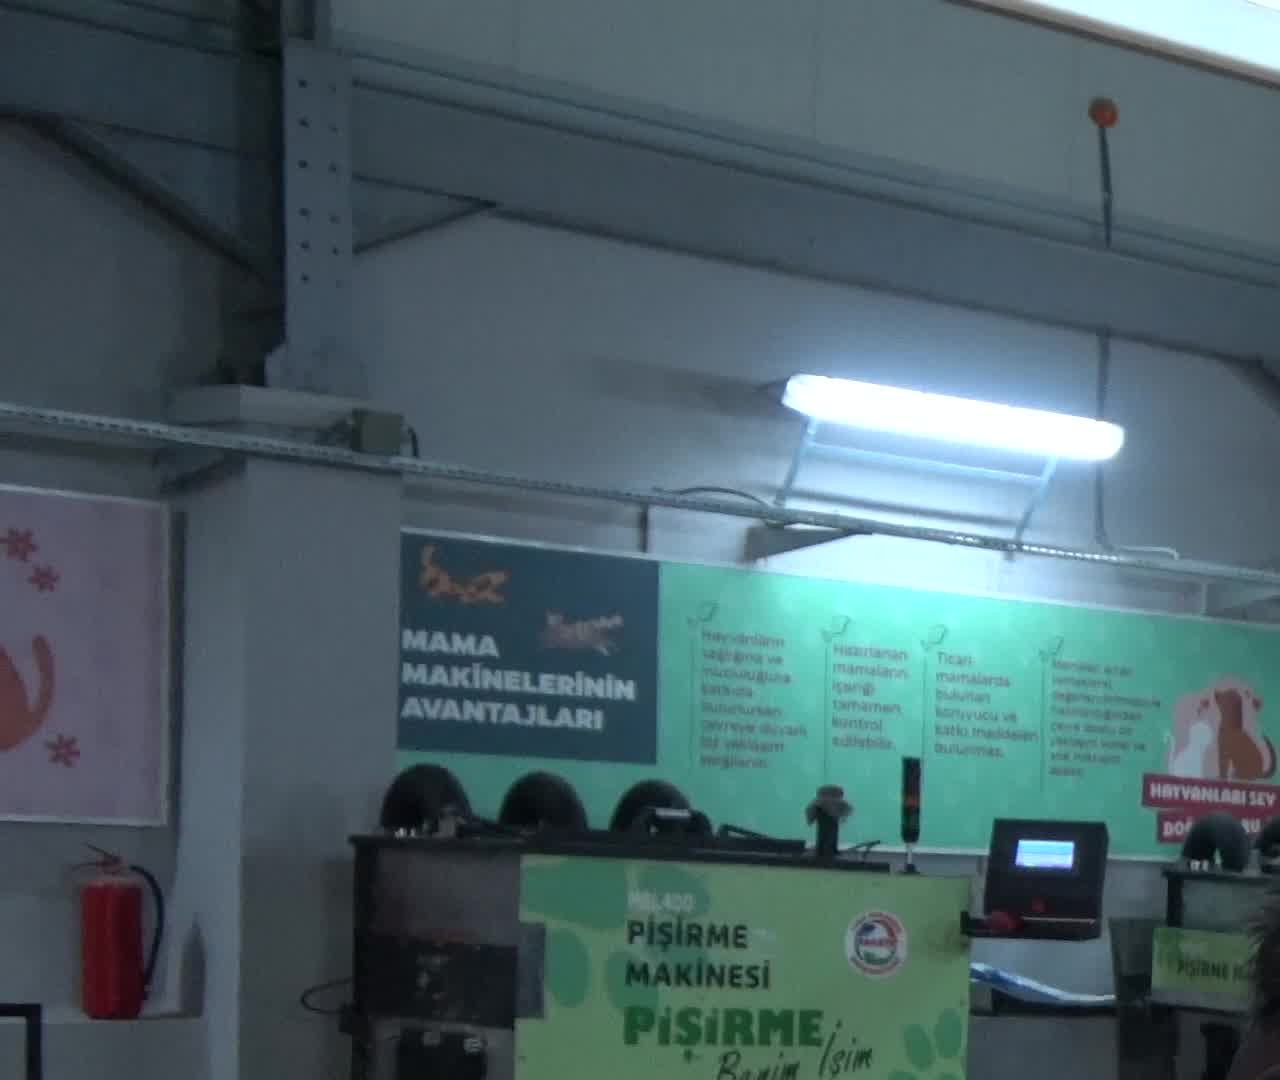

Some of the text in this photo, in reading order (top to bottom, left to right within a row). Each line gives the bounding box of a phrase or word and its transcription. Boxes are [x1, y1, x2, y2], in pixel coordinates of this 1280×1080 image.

[402, 629, 500, 658] MAMA
[402, 662, 637, 701] MAKİNELERİNİN
[401, 697, 604, 731] AVANTAJLARI
[627, 913, 748, 952] PİŞİRME
[625, 959, 770, 990] MAKİNESİ
